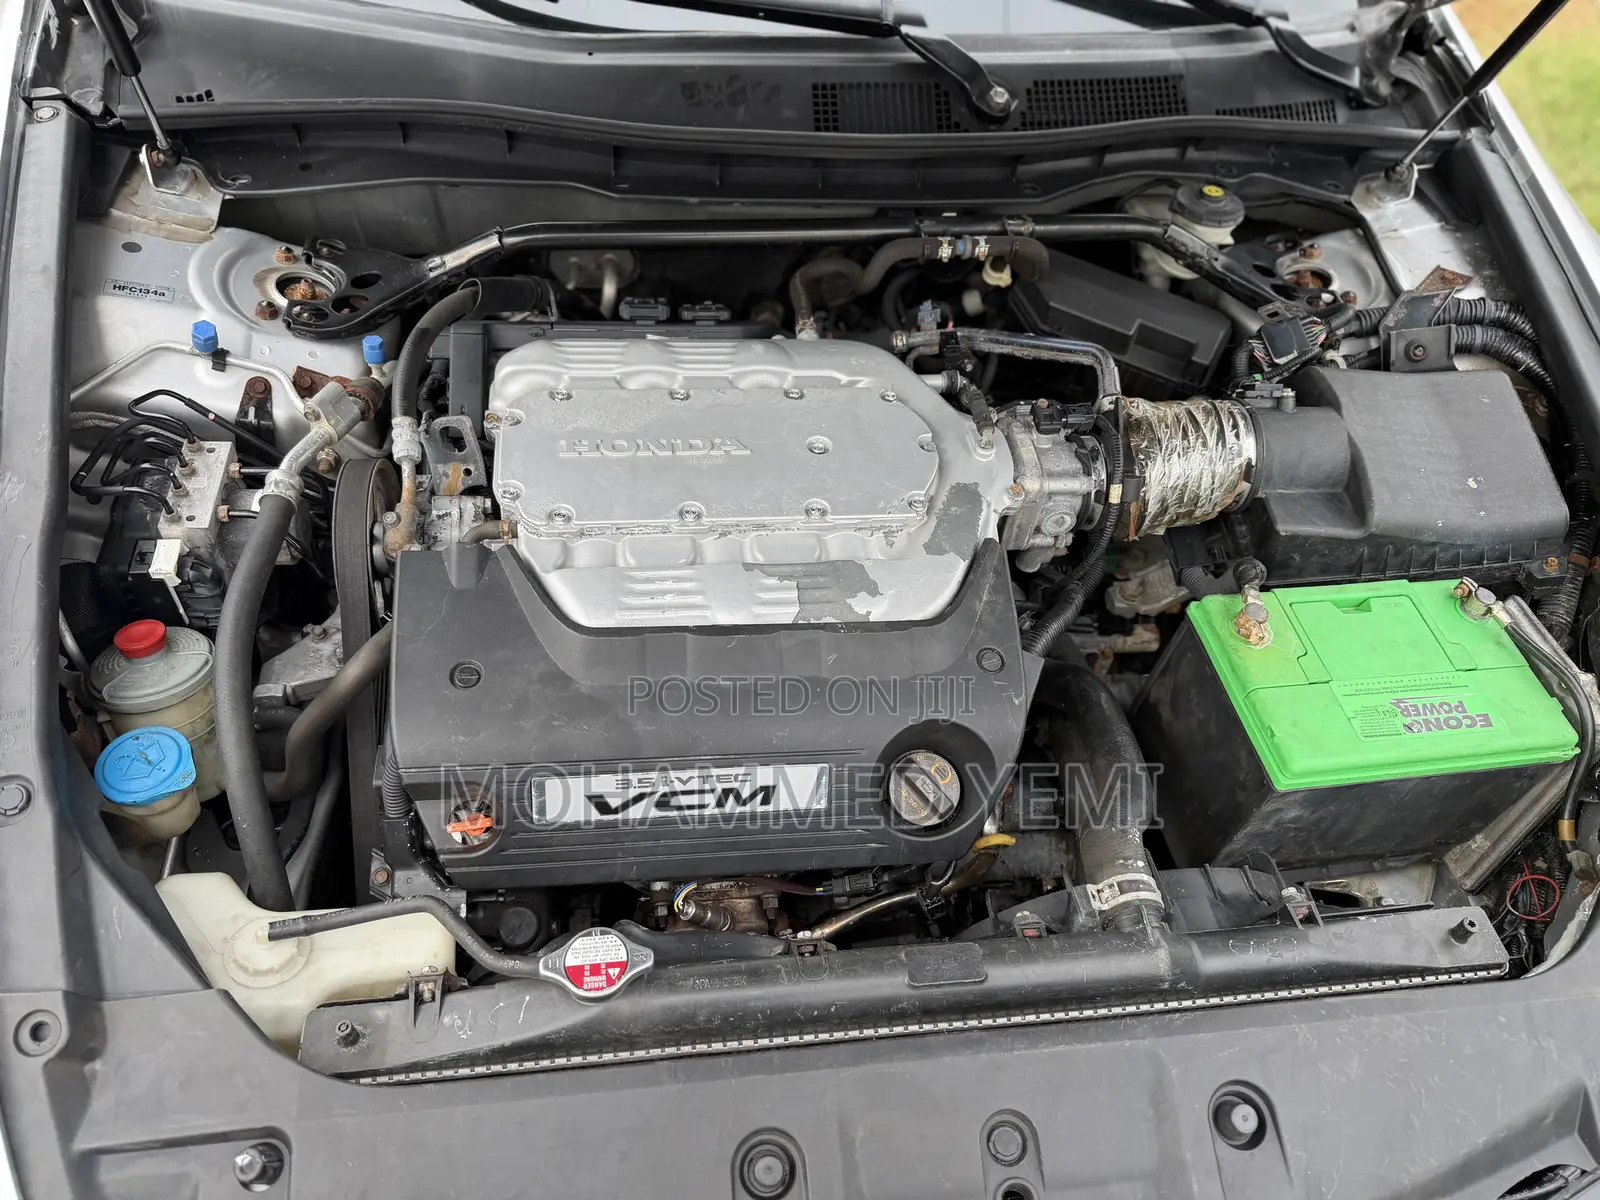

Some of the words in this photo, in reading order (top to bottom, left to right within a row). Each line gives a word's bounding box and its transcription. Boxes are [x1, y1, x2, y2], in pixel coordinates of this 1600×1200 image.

[112, 284, 166, 297] HFC134a
[559, 437, 752, 457] HONDA
[1390, 700, 1468, 718] POWER
[584, 784, 777, 816] VCM
[583, 981, 607, 989] DANGER
